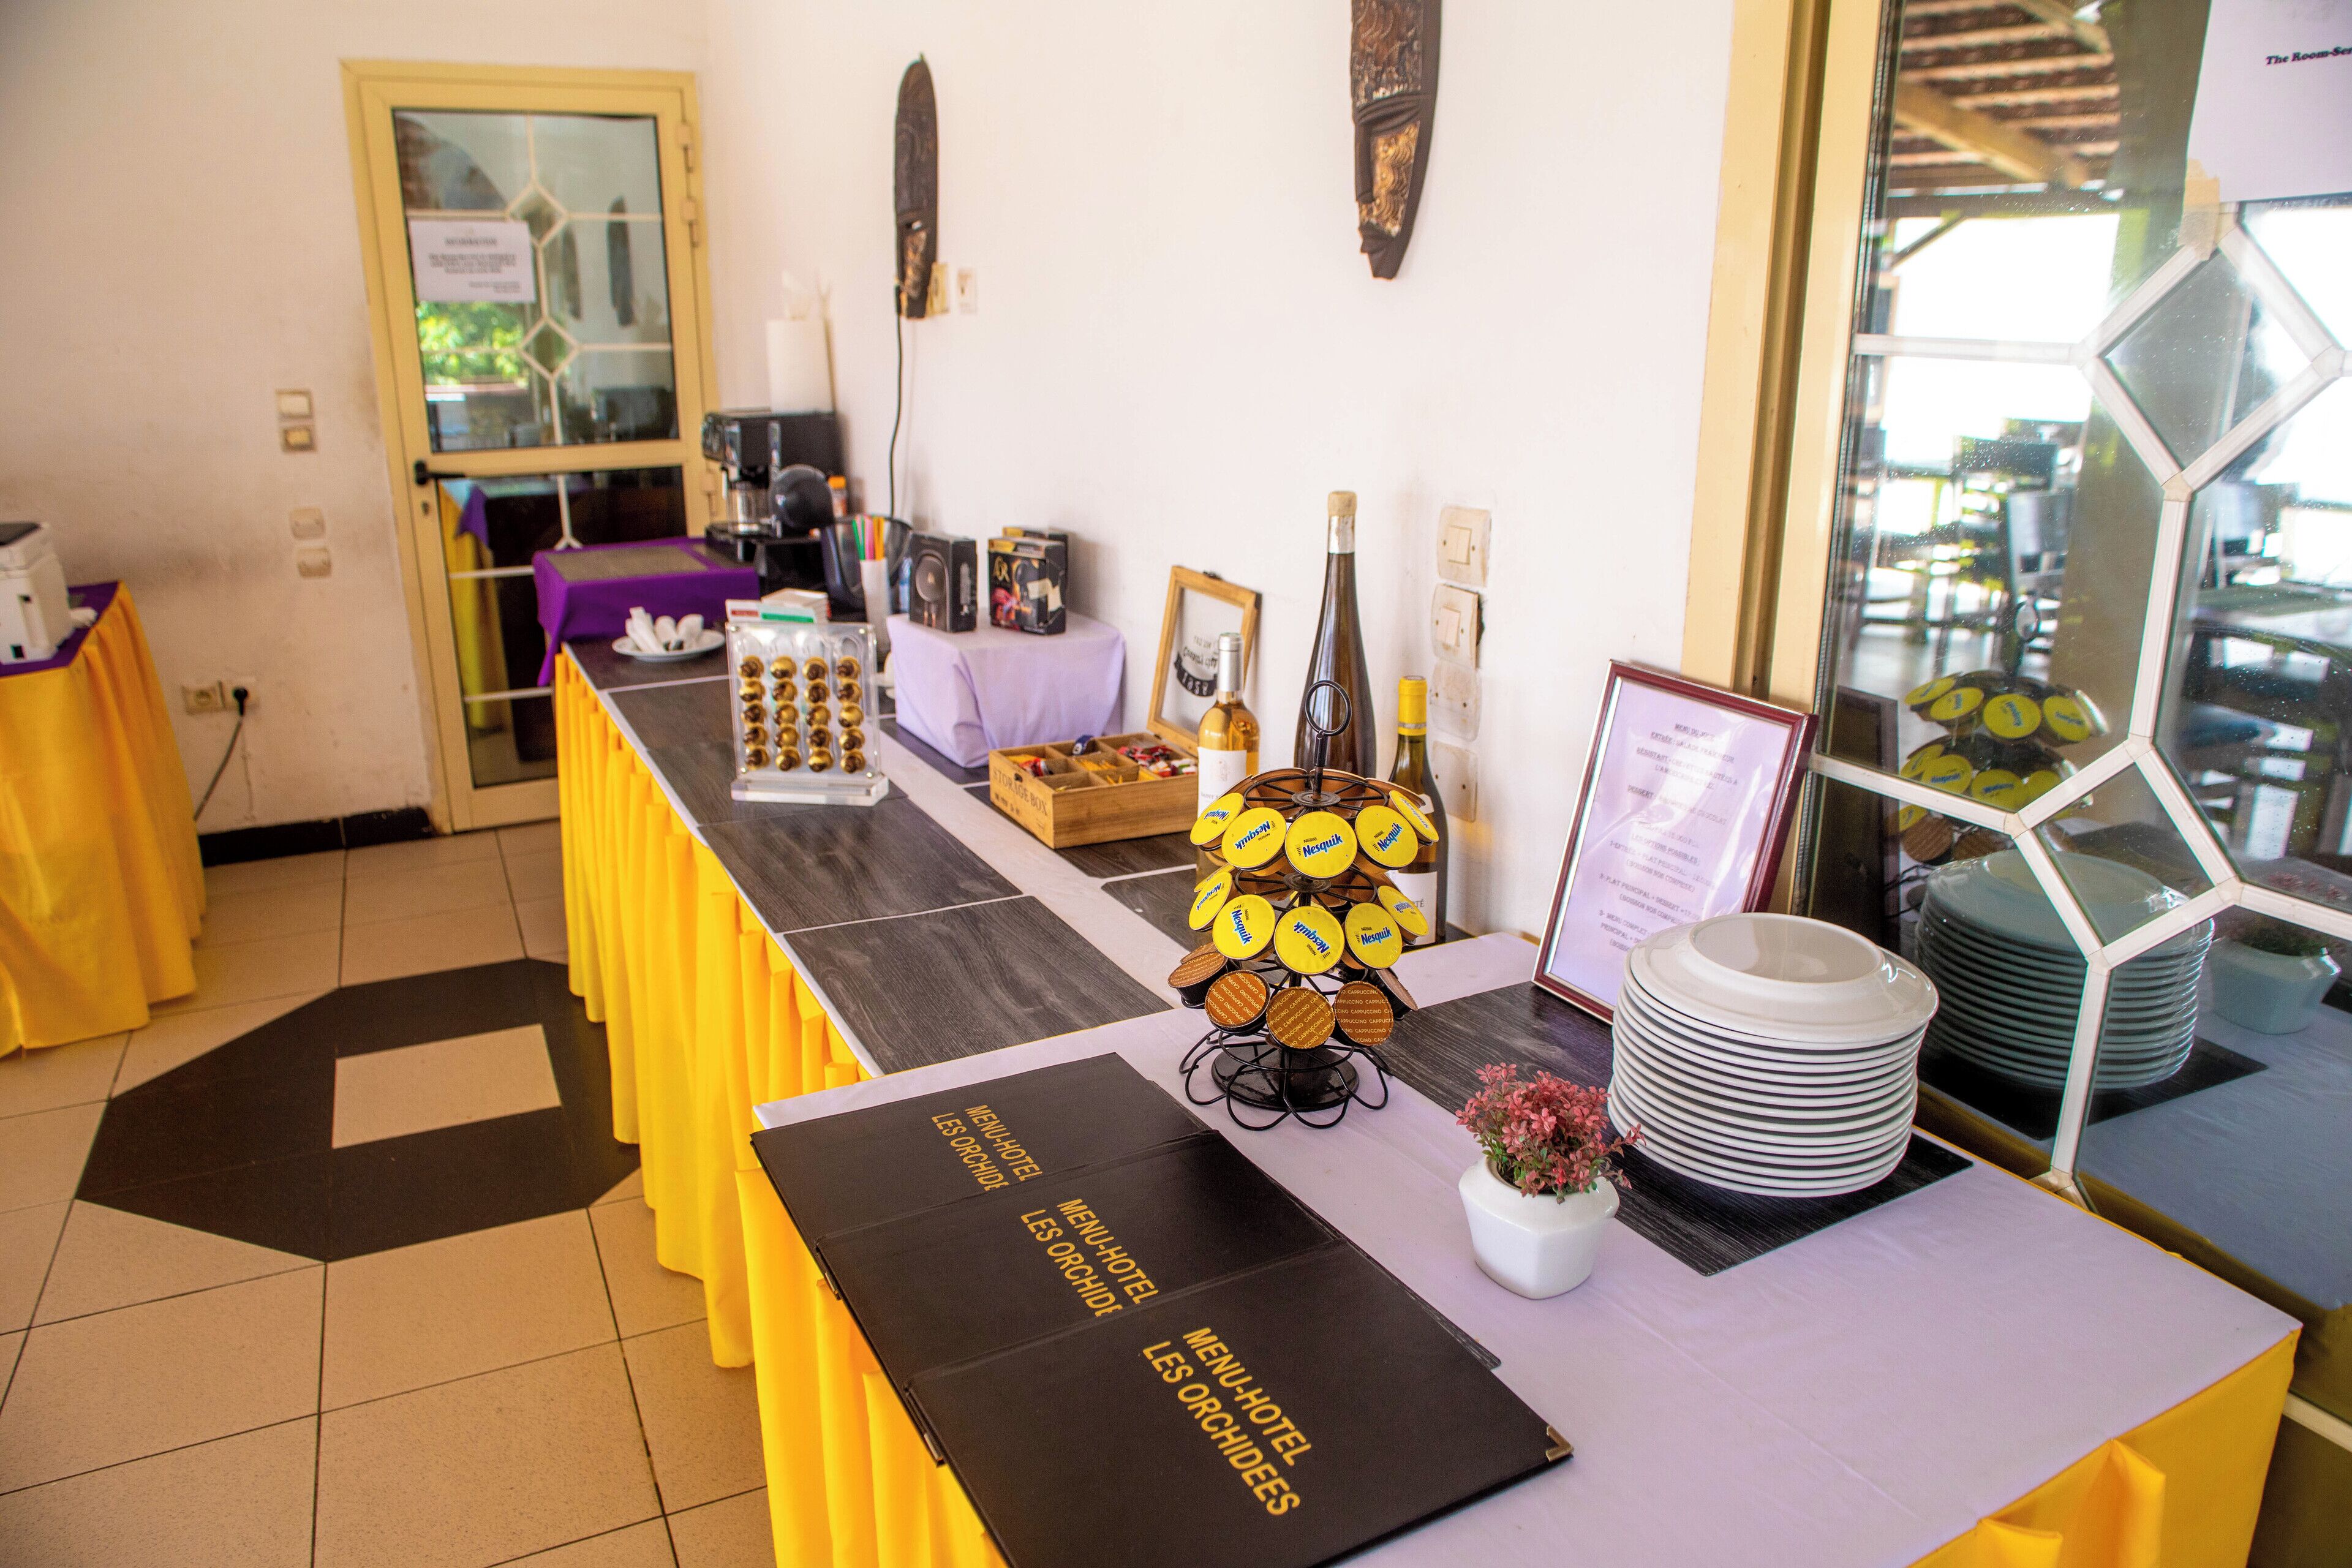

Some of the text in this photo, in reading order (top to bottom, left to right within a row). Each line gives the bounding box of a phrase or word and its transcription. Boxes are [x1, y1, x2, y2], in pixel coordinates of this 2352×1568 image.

[2266, 54, 2290, 66] The
[1235, 820, 1271, 850] Nesquik
[1303, 834, 1343, 858] Nesquik
[1377, 822, 1403, 851] Nesquik
[1231, 909, 1253, 944] Nesquik
[1294, 921, 1330, 954] Nesquik
[1360, 927, 1392, 945] Nesquik
[1220, 984, 1243, 1008] CAPPUCCINO
[1239, 989, 1262, 1011] CAPPUCCINO
[1269, 989, 1295, 1013] CAPPUCCINO
[1224, 1001, 1246, 1023] CAPPUCCINO
[1283, 1004, 1310, 1028] CAPPUCCINO
[1298, 1017, 1325, 1041] CAPPUCCINO
[931, 1112, 967, 1136] LES
[965, 1104, 1042, 1182] MENU-HOTEL
[1020, 1209, 1063, 1242] LES
[1057, 1198, 1159, 1304] MENU-HOTEL
[1183, 1327, 1312, 1466] MENU-HOTEL
[1142, 1341, 1301, 1516] LES ORCHIDEES
